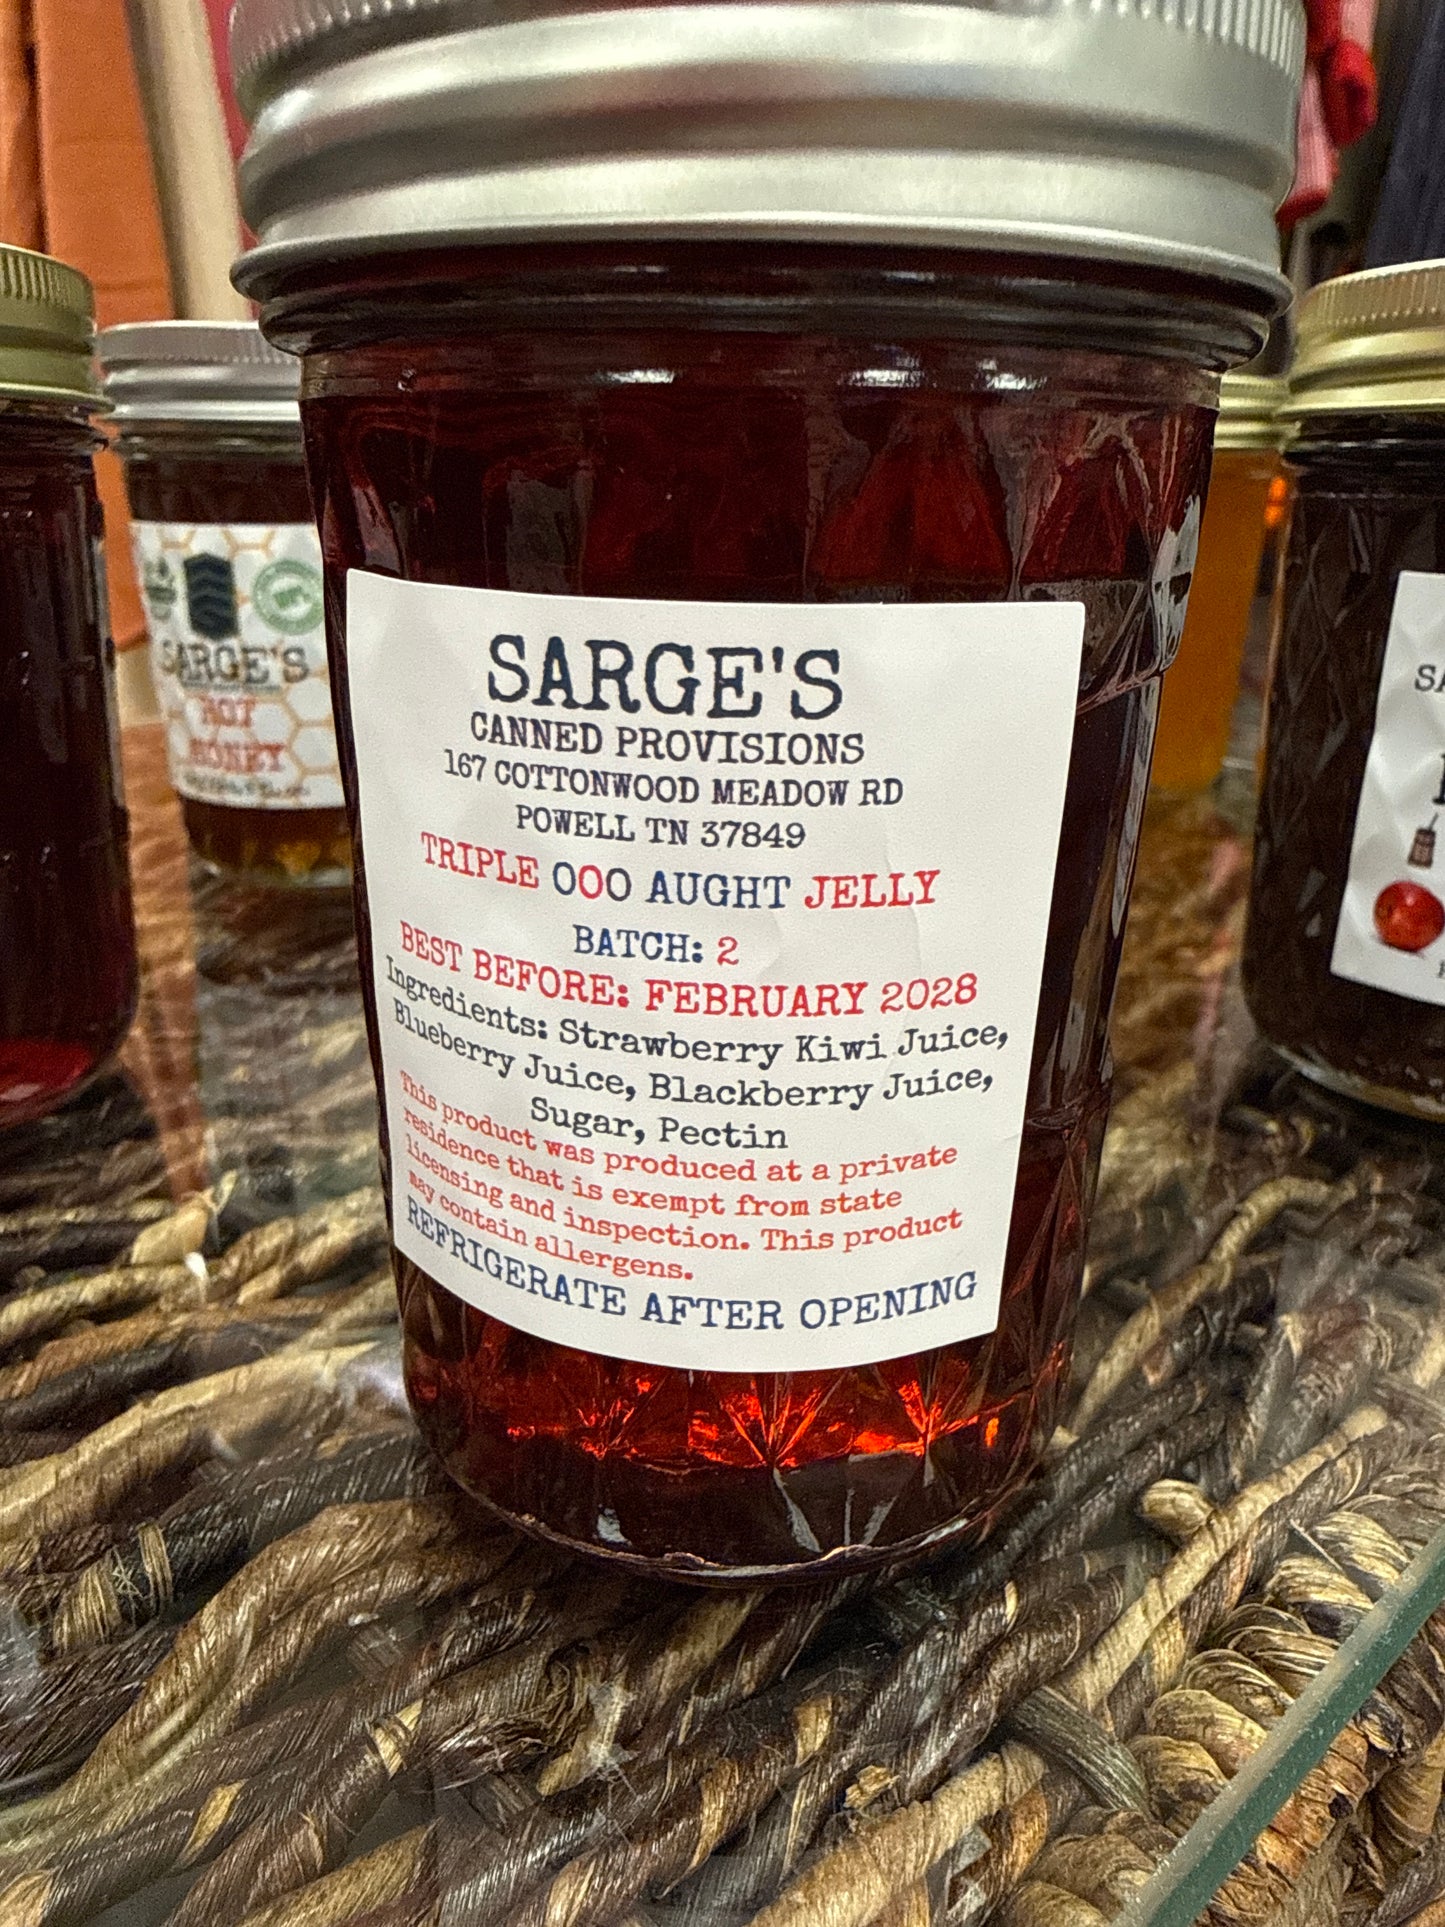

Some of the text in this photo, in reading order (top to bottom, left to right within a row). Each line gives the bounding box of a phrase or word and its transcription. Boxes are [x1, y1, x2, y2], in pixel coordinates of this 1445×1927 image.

[488, 634, 842, 720] SARGE'S
[444, 749, 903, 807] 167 COTTONWOOD MEADOW RD
[471, 711, 864, 765] CANNED PROVISIONS
[421, 832, 539, 888] TRIPLE
[645, 871, 791, 909] AUGHT
[804, 869, 940, 909] JELLY
[516, 804, 806, 849] POWELL TN 37849
[400, 920, 977, 1017] BEST BEFORE: FEBRUARY 2028
[572, 924, 739, 966] BATCH: 2
[386, 955, 1008, 1070] Ingredients: Strawberry Kiwi Juice,
[394, 998, 993, 1111] Blueberry Juice, Blackberry Juice,
[401, 1071, 957, 1185] This product was produced at a private
[405, 1108, 902, 1219] residence that is exempt from state
[531, 1097, 788, 1149] Sugar, Pectin
[407, 1134, 962, 1253] licensing and inspection. This product
[410, 1171, 693, 1280] may contain allergens.
[408, 1195, 977, 1330] REFRIGERATE AFTER OPENING
